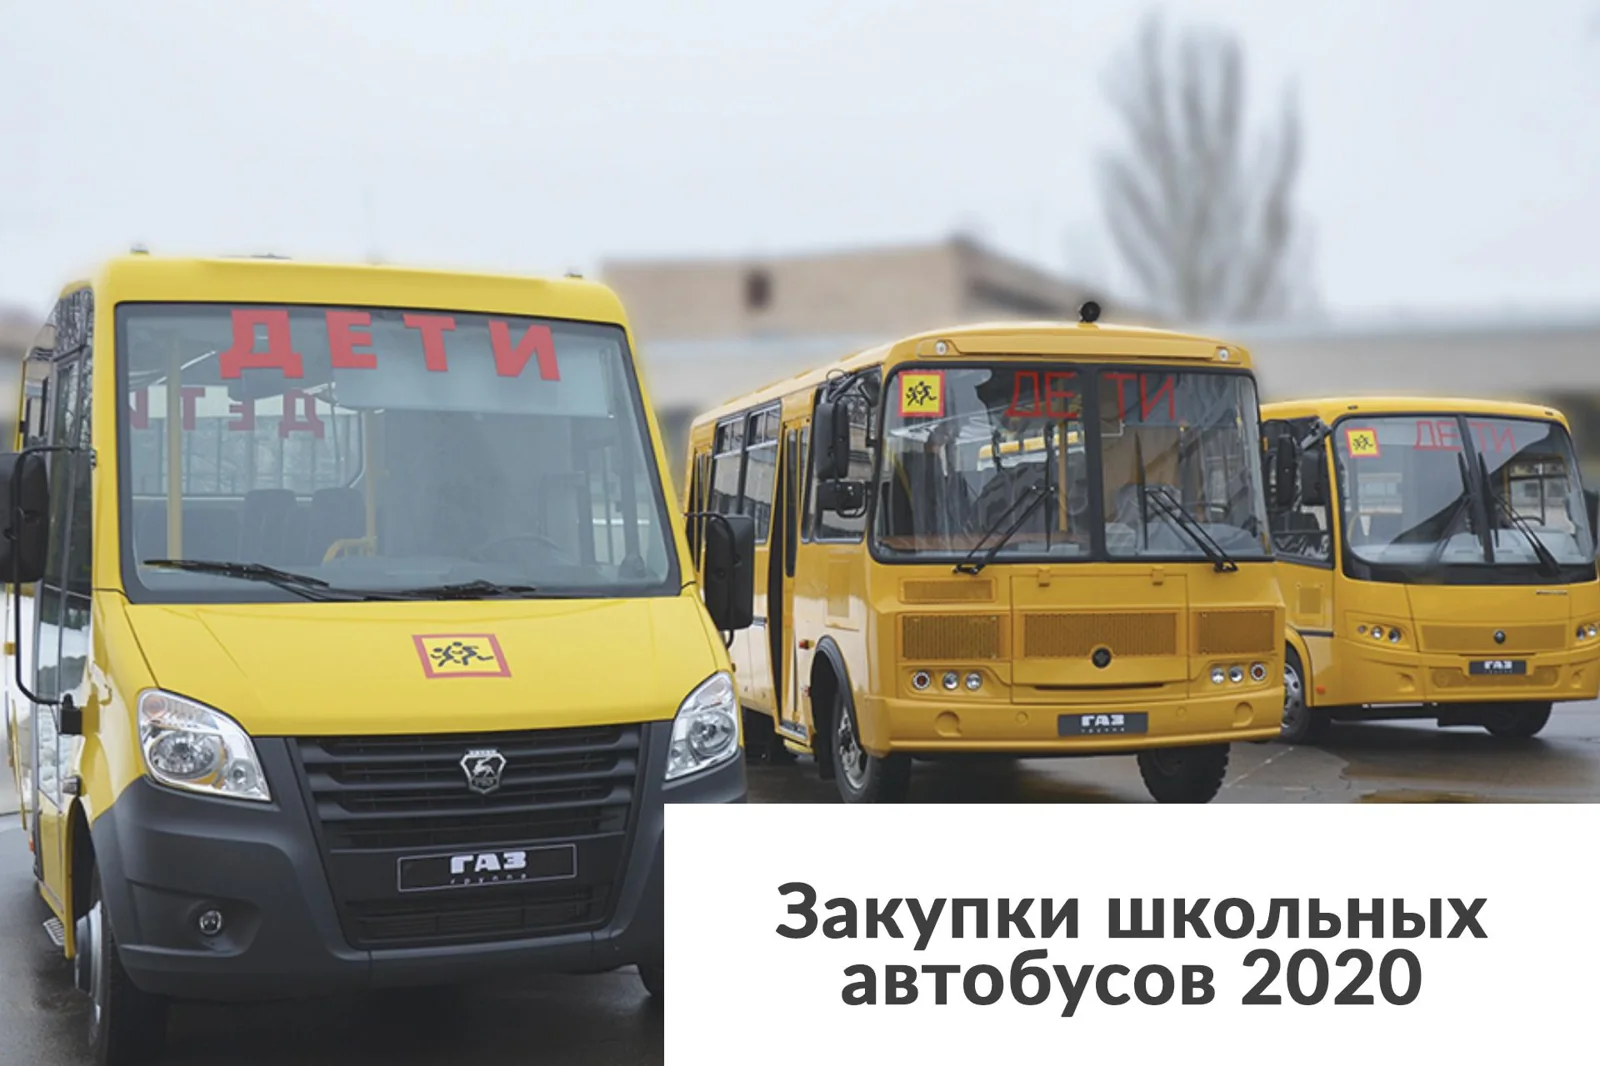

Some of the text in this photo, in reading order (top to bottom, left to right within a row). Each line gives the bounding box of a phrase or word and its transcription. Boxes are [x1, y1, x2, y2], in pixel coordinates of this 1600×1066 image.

[219, 309, 560, 381] ДЕТИ
[1005, 370, 1175, 422] ДЕТИ
[1413, 420, 1517, 454] ДЕТИ
[1081, 714, 1125, 727] ГАЗ
[450, 851, 527, 874] ГАЗ
